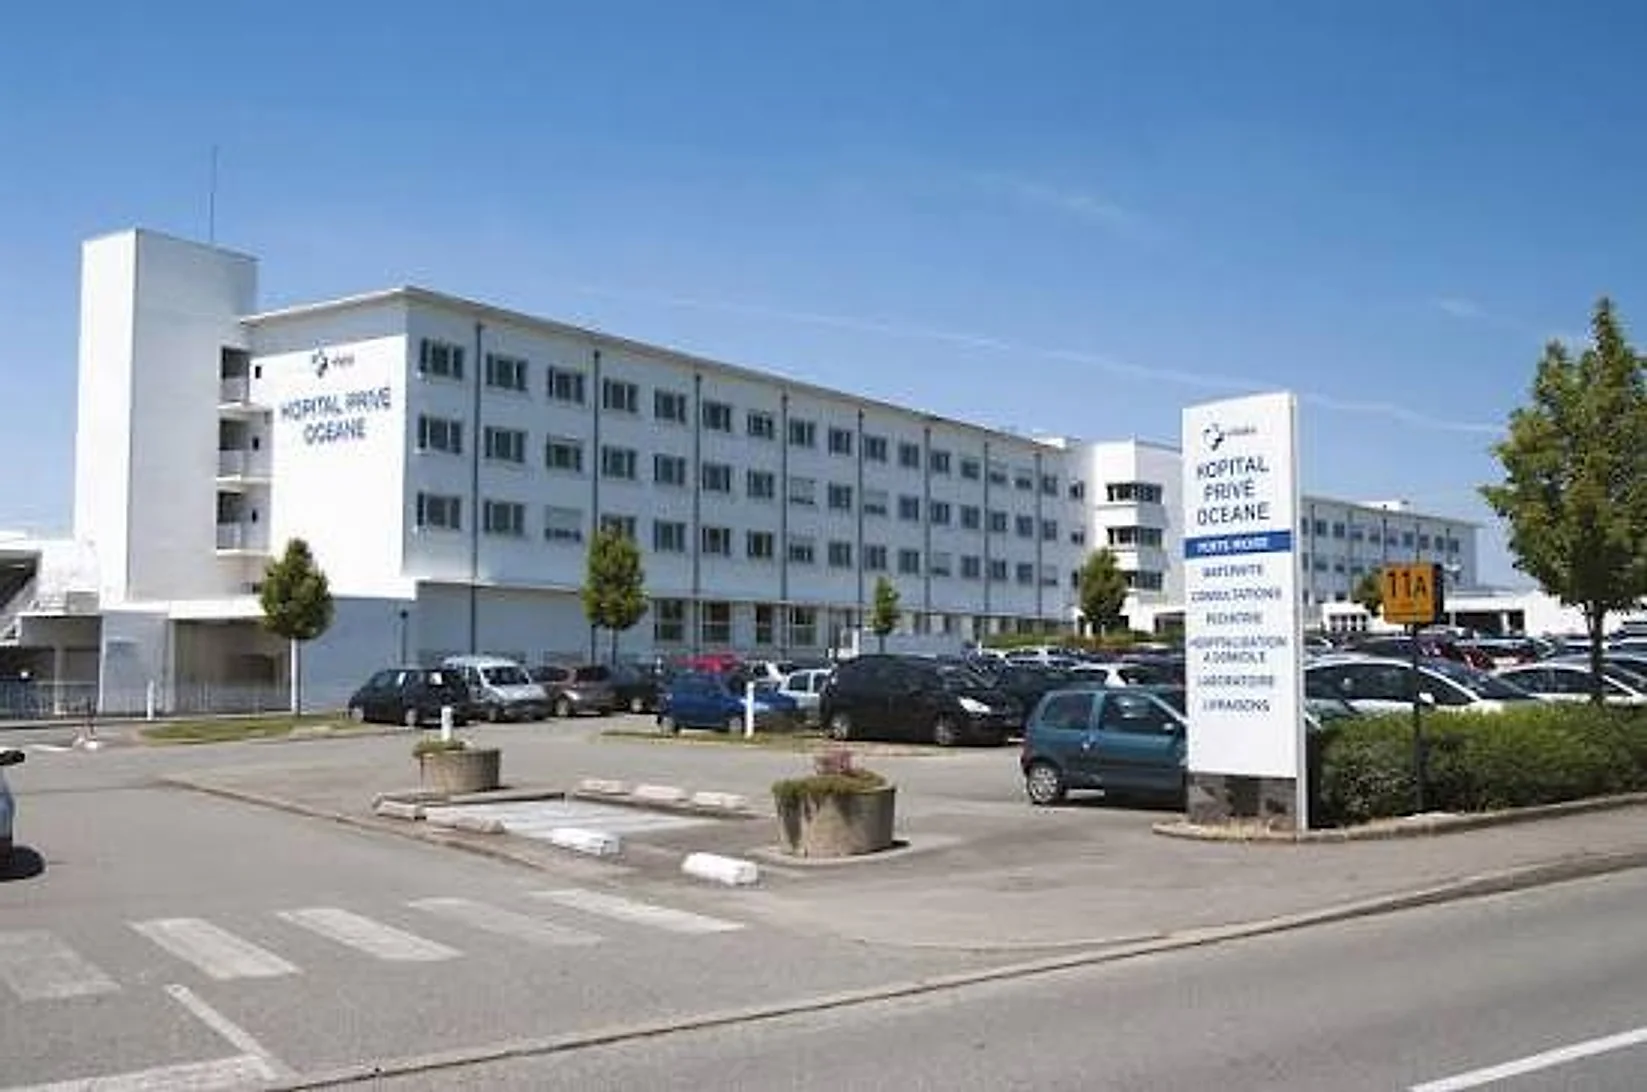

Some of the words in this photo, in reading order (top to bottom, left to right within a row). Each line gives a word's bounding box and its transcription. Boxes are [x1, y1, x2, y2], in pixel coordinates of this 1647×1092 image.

[1197, 456, 1270, 480] HOPITAL
[1197, 501, 1270, 526] OCEANE
[1387, 570, 1427, 598] 11A
